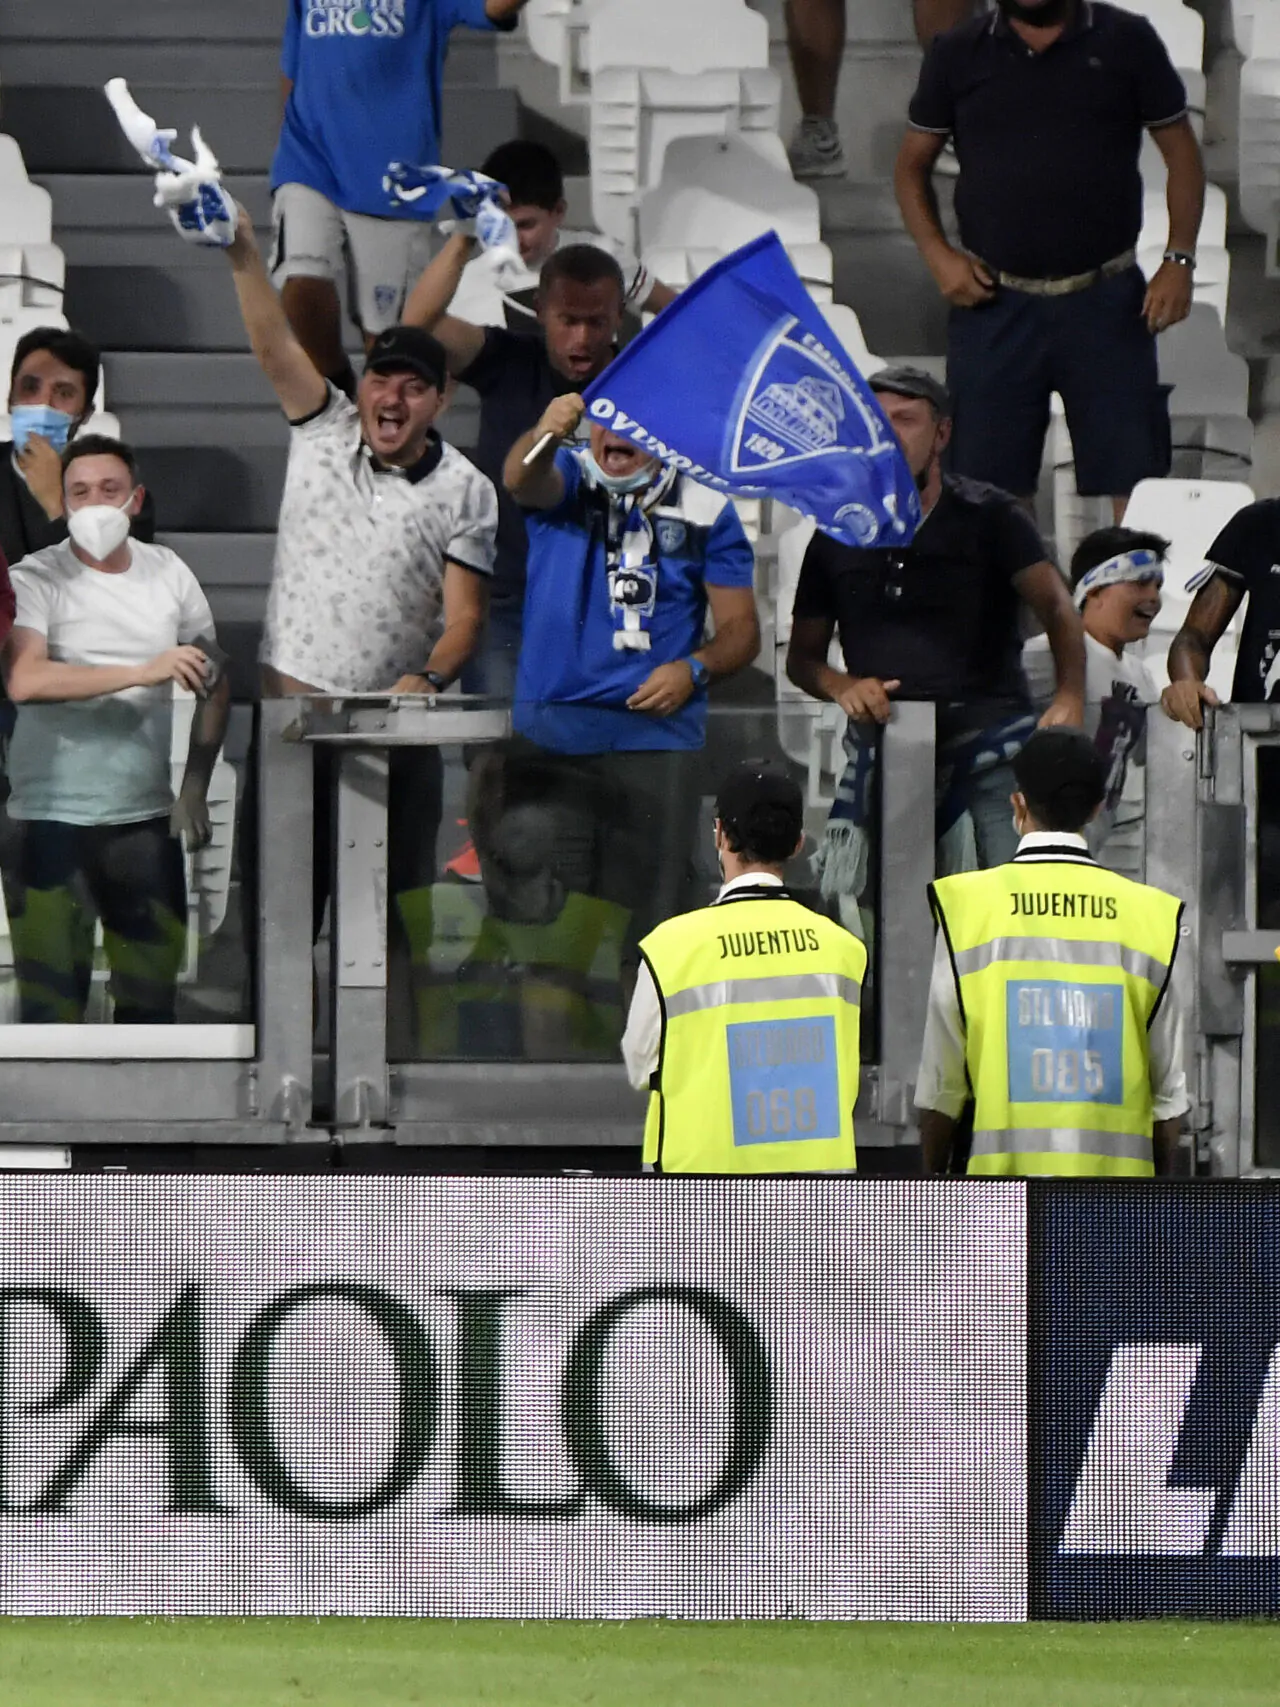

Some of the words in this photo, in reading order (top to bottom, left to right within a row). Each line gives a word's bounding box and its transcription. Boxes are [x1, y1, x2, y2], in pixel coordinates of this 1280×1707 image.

[306, 7, 405, 37] GROSS
[1010, 892, 1118, 920] JUVENTUS
[717, 928, 819, 959] JUVENTUS
[1031, 1048, 1104, 1094] 085
[746, 1086, 818, 1137] 068
